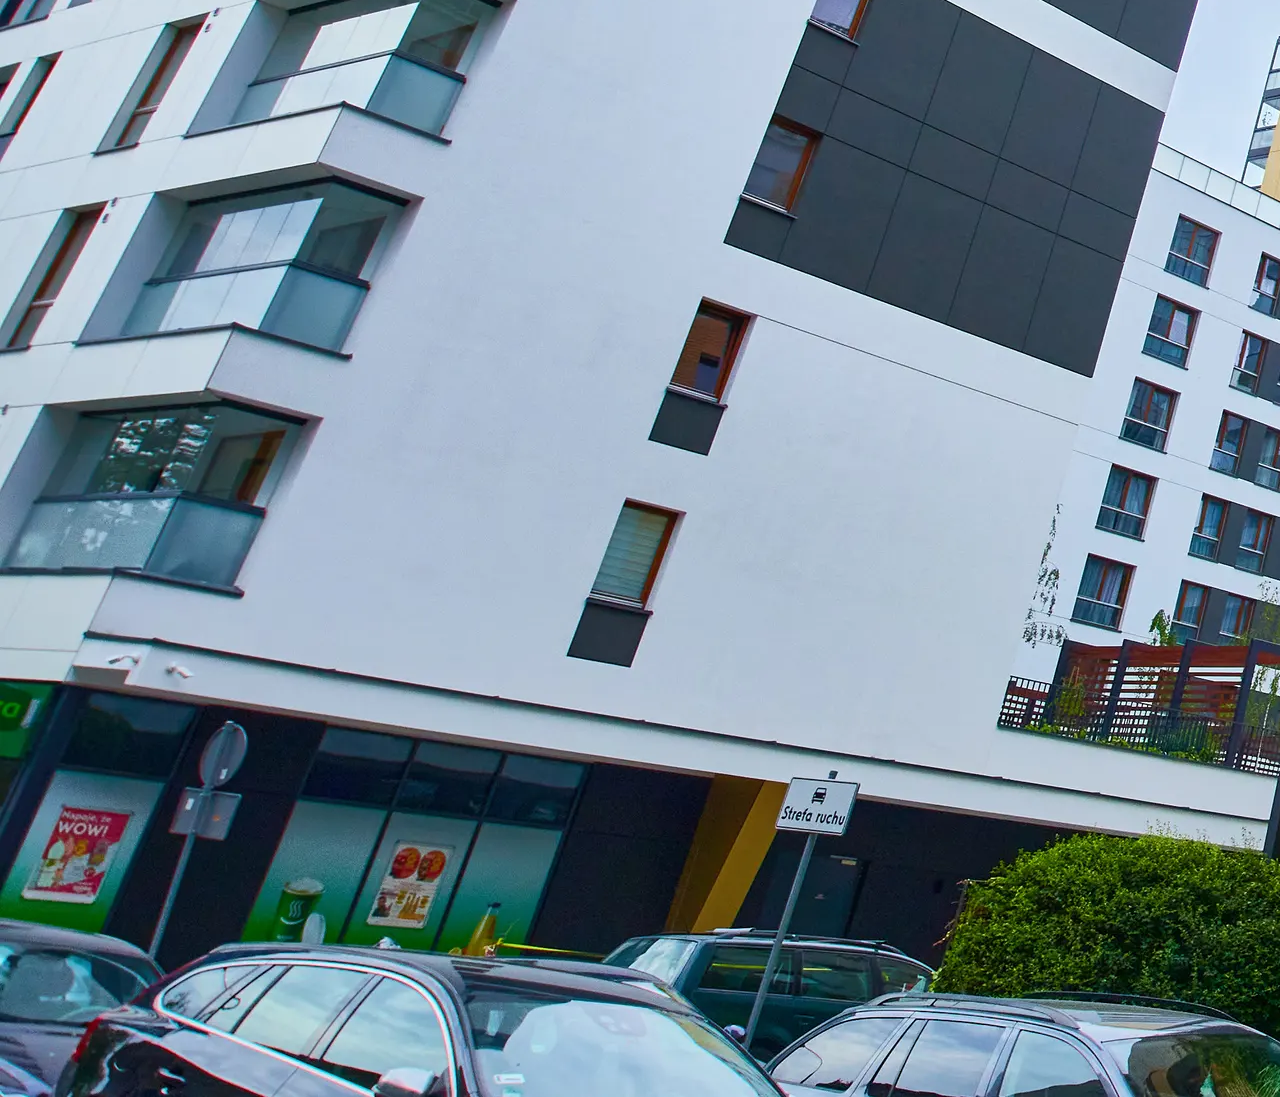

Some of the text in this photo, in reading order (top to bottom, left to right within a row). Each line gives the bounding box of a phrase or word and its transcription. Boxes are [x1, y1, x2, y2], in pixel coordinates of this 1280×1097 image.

[781, 805, 846, 826] Strefa ruchu
[59, 821, 109, 837] WOW!
